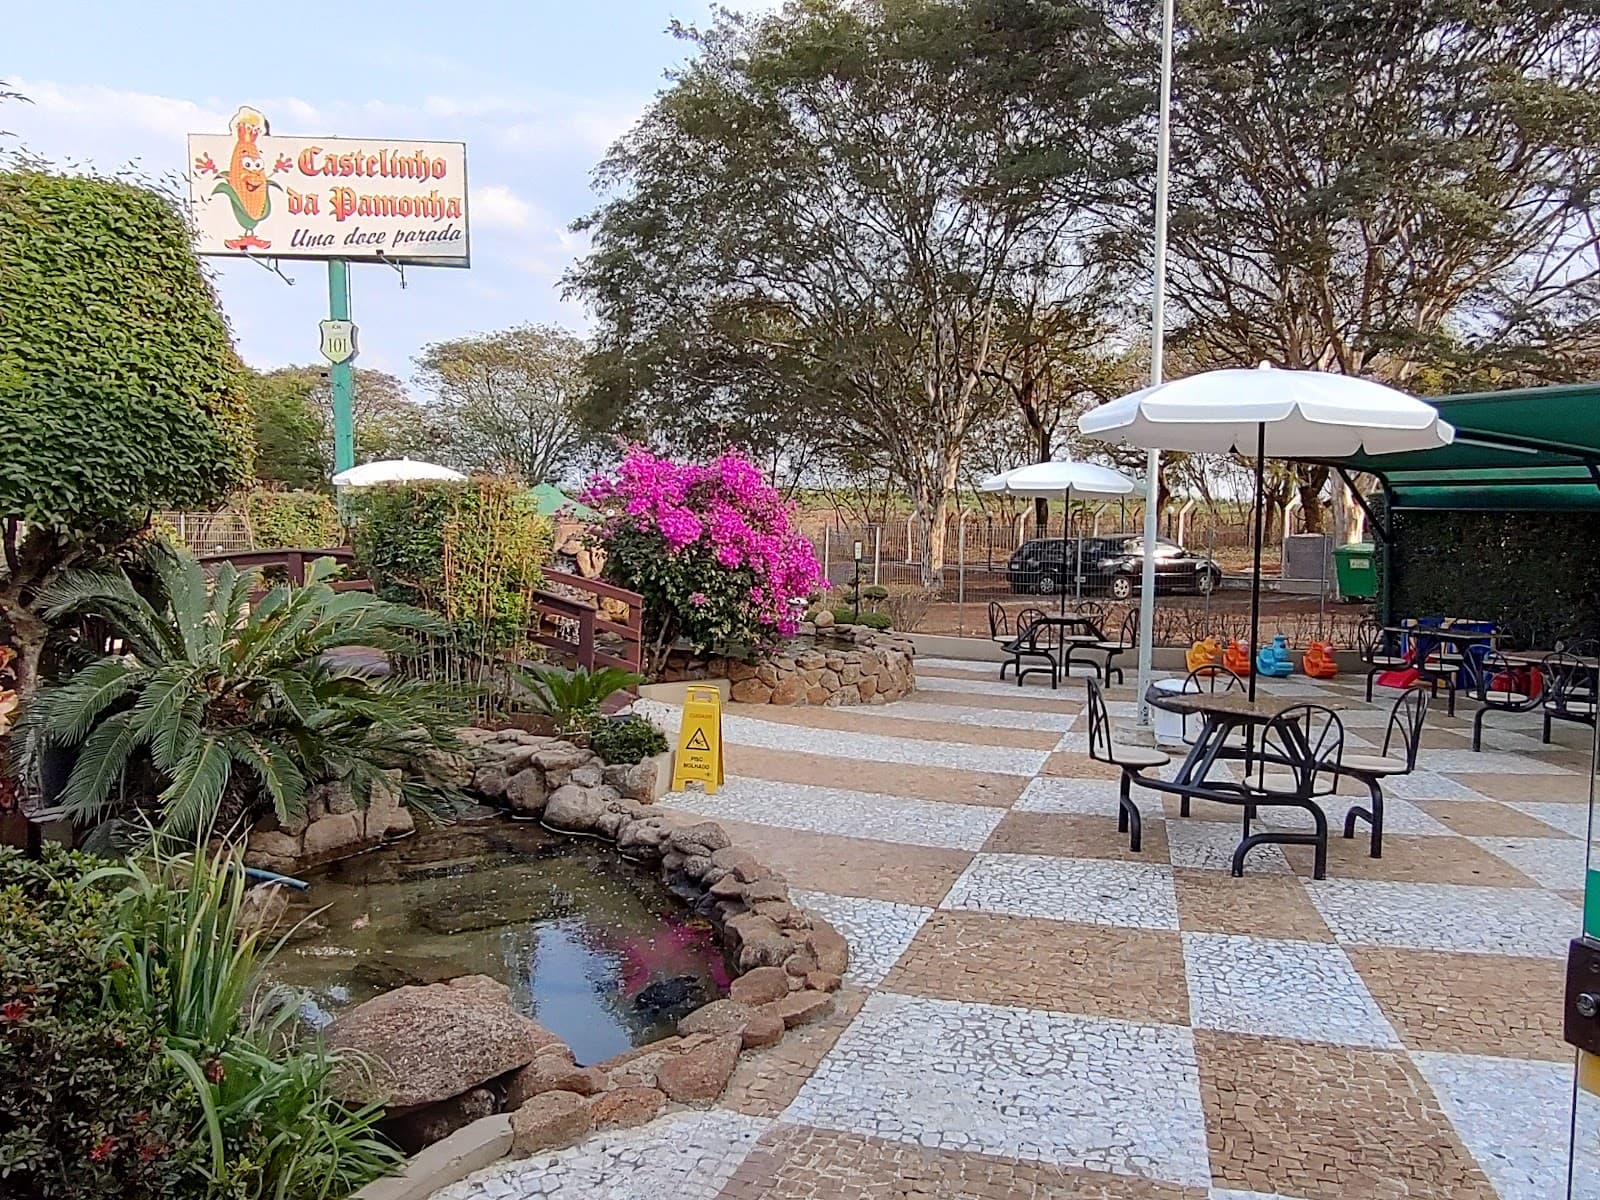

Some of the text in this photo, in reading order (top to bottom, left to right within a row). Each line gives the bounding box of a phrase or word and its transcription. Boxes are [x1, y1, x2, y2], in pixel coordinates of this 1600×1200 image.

[297, 146, 447, 183] Castelinho
[287, 186, 463, 222] da Pamonha
[290, 223, 463, 248] Uma doce parada
[328, 336, 347, 353] 101
